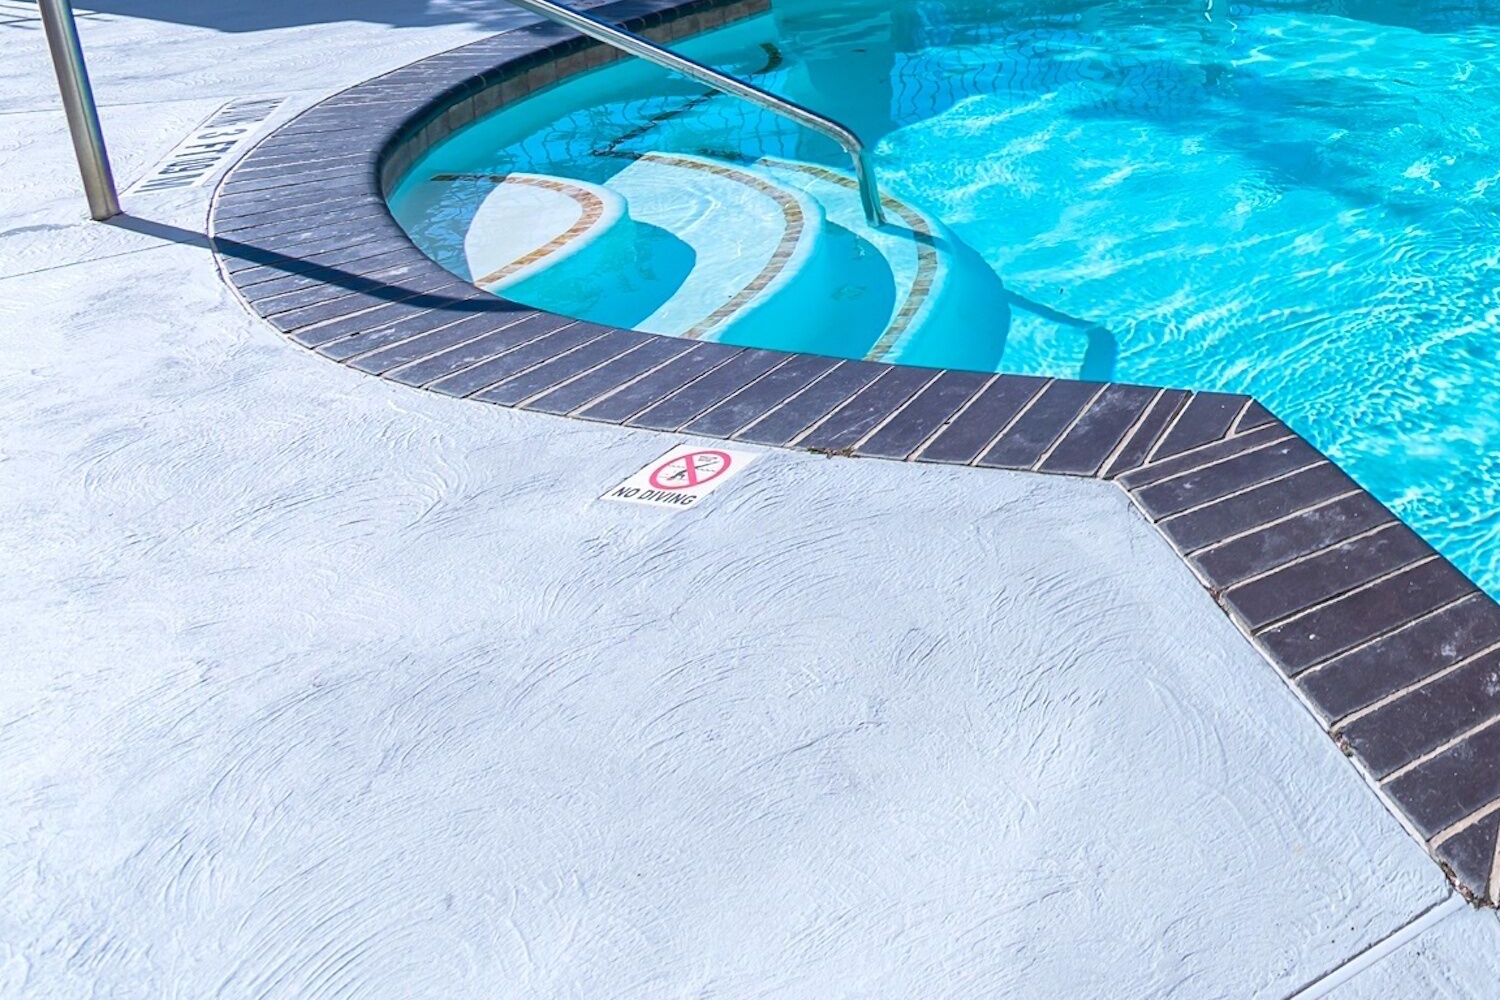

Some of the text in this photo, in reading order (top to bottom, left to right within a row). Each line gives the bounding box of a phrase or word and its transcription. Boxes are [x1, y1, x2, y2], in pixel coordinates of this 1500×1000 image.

[197, 128, 248, 139] 3
[175, 140, 238, 158] FT
[134, 172, 204, 194] M
[612, 486, 697, 505] NO DIVING
